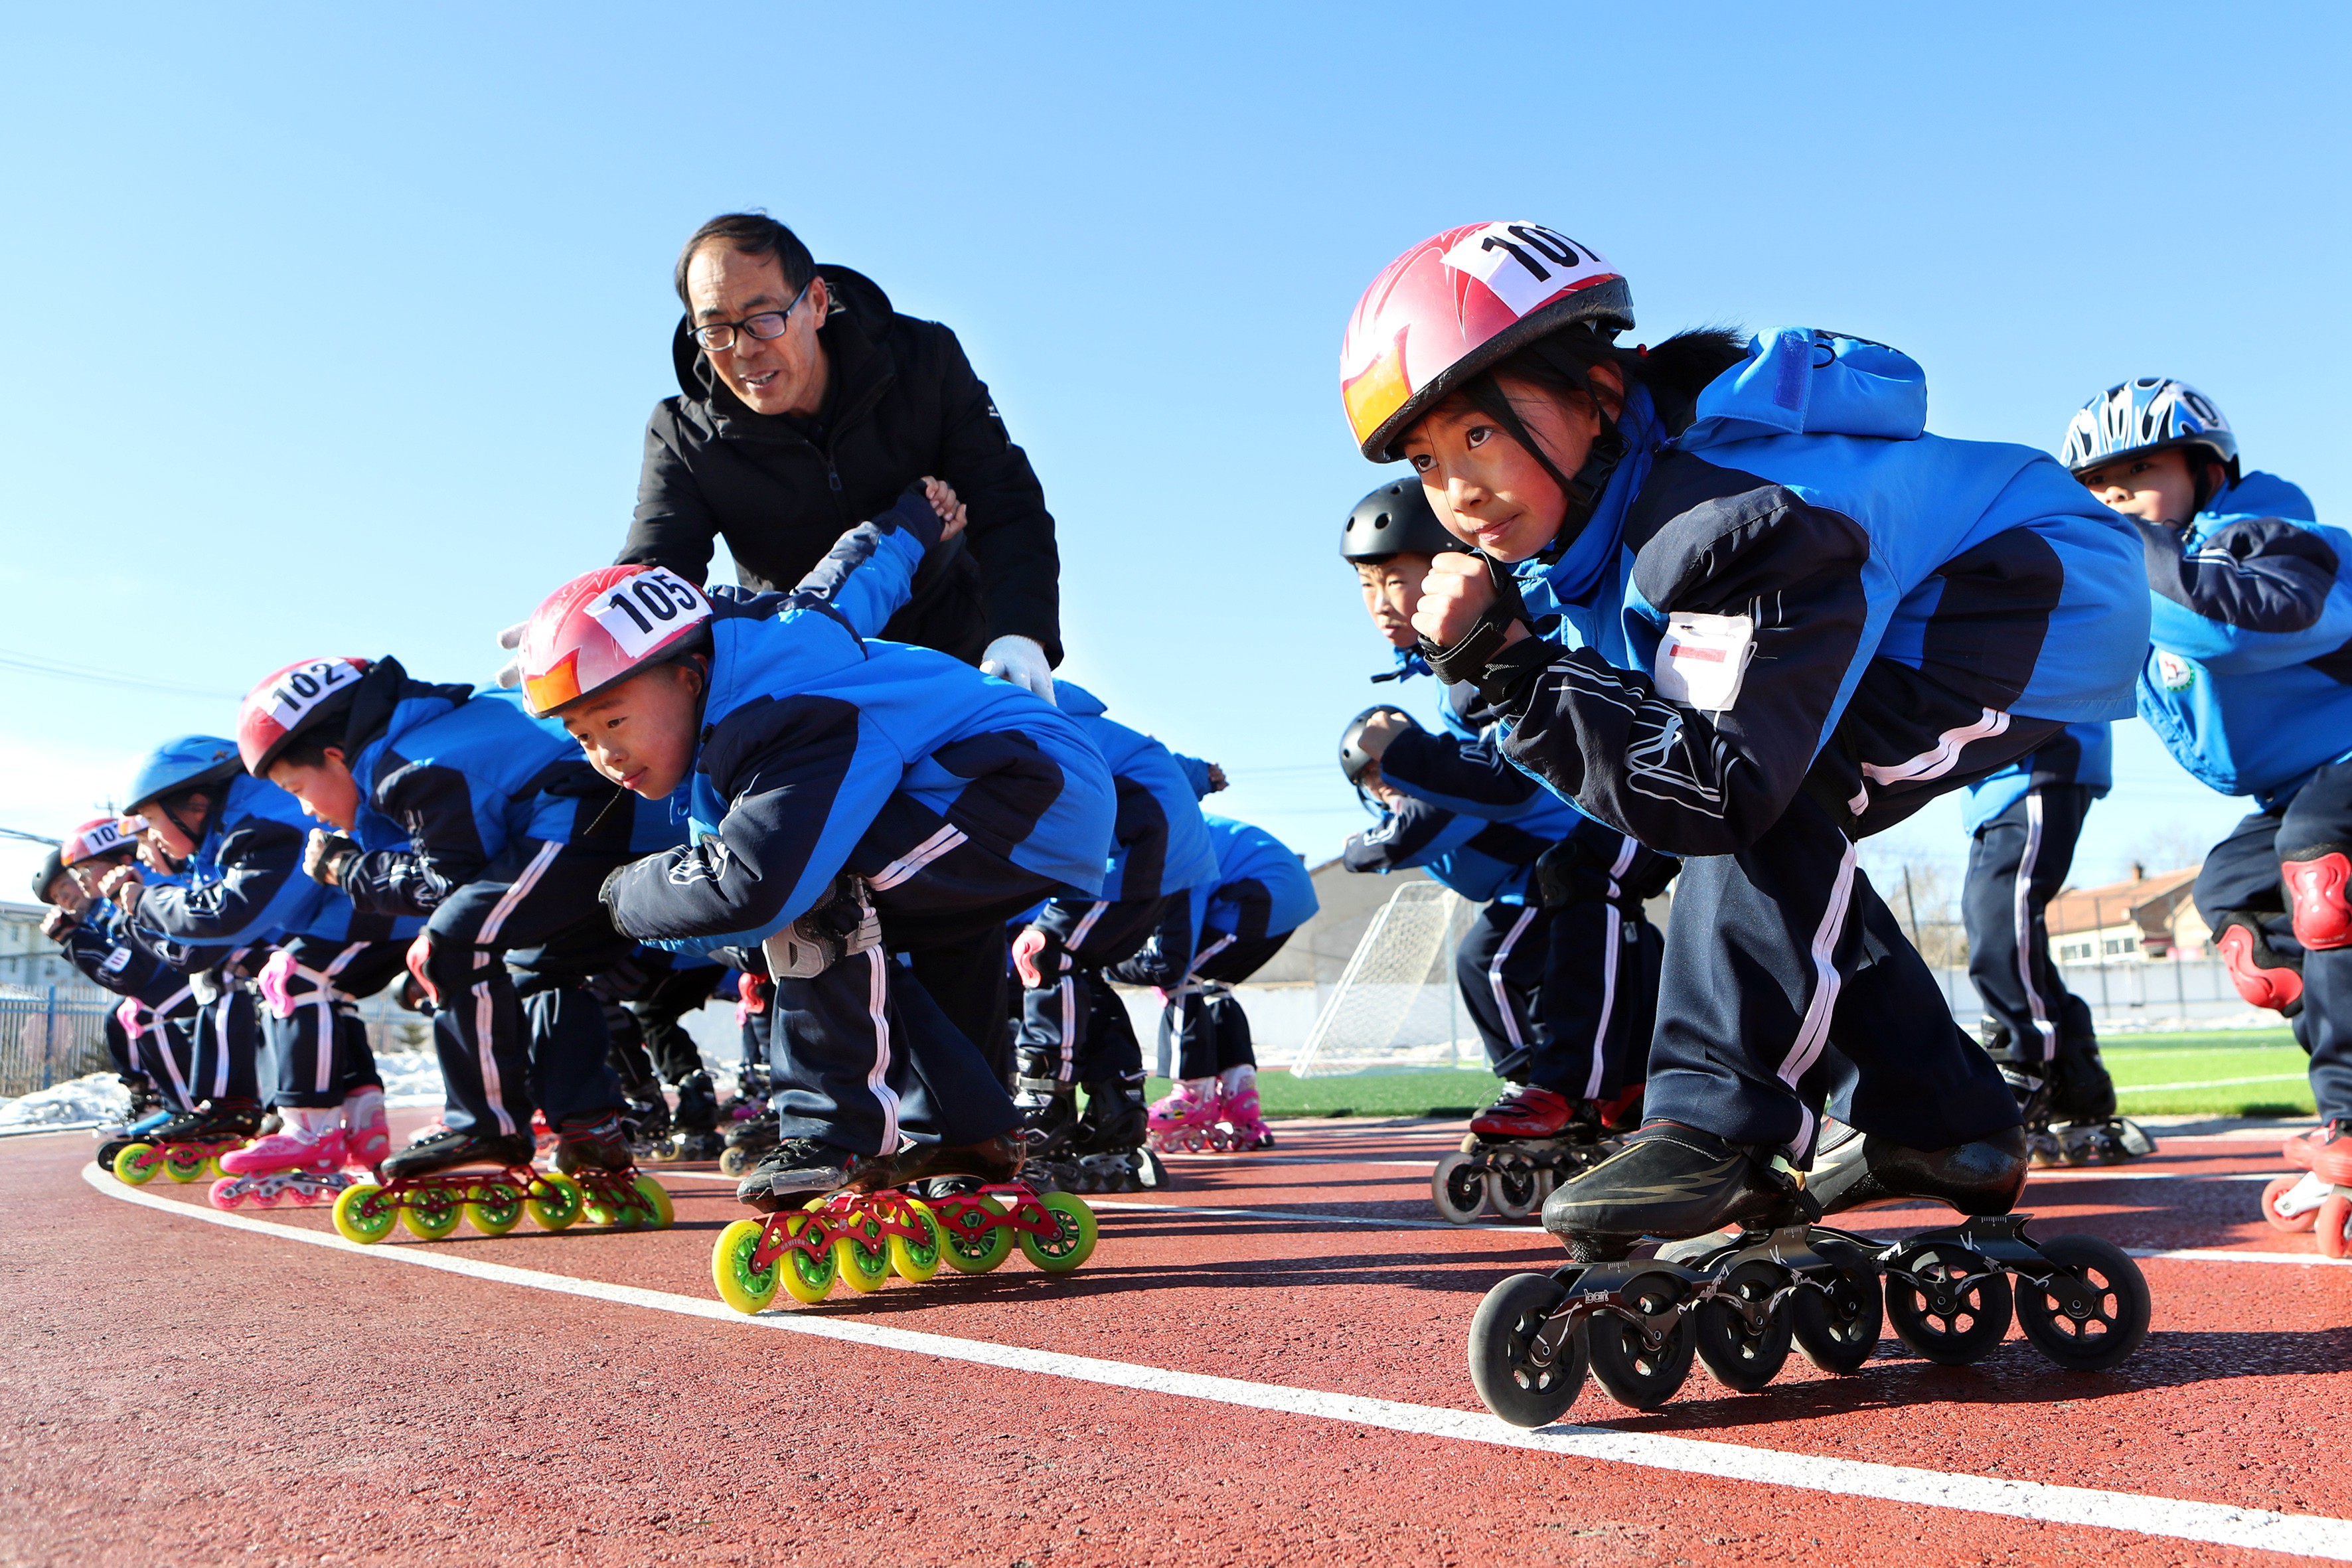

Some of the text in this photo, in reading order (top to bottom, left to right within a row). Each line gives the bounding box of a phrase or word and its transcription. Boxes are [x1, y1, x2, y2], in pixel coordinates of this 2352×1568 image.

[609, 574, 697, 635] 105
[272, 663, 346, 712] 102
[90, 823, 118, 846] 10
